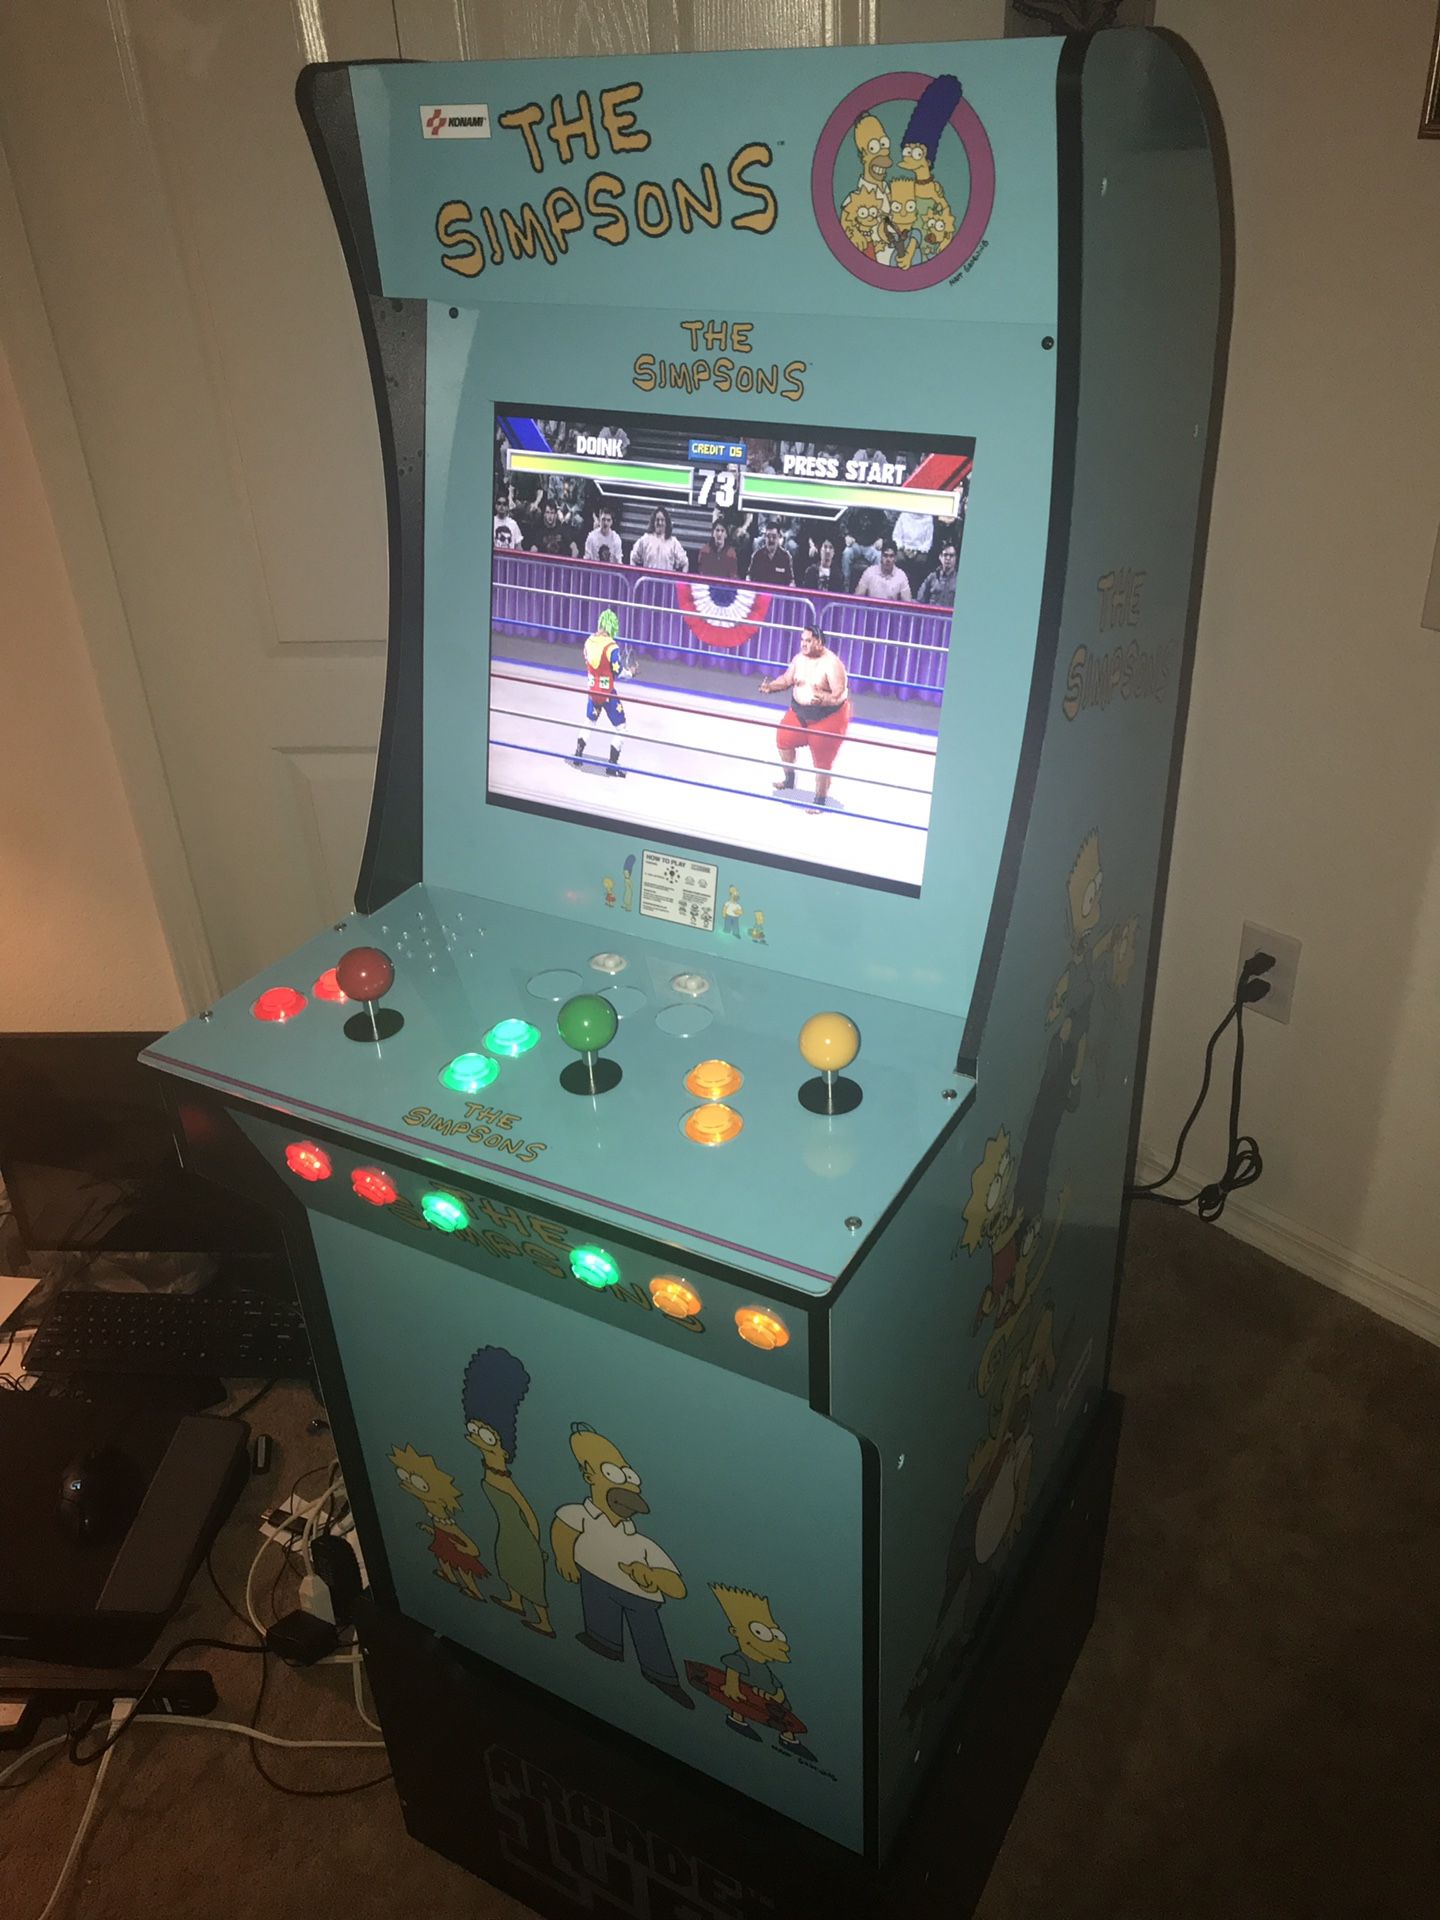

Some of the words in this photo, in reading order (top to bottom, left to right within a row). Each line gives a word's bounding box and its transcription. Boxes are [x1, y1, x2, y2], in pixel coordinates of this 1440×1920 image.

[448, 117, 484, 127] KONAMI
[499, 81, 652, 173] THE
[435, 141, 778, 278] SIMPSONS
[680, 320, 754, 354] THE
[632, 353, 807, 401] SIMPSONS
[576, 435, 624, 458] DOINK
[691, 443, 725, 456] CREDIT
[783, 454, 840, 479] PRESS
[845, 459, 907, 485] START
[697, 469, 736, 507] 73
[662, 857, 670, 865] TO
[464, 1101, 522, 1131] THE
[402, 1106, 548, 1163] SIMPSONS
